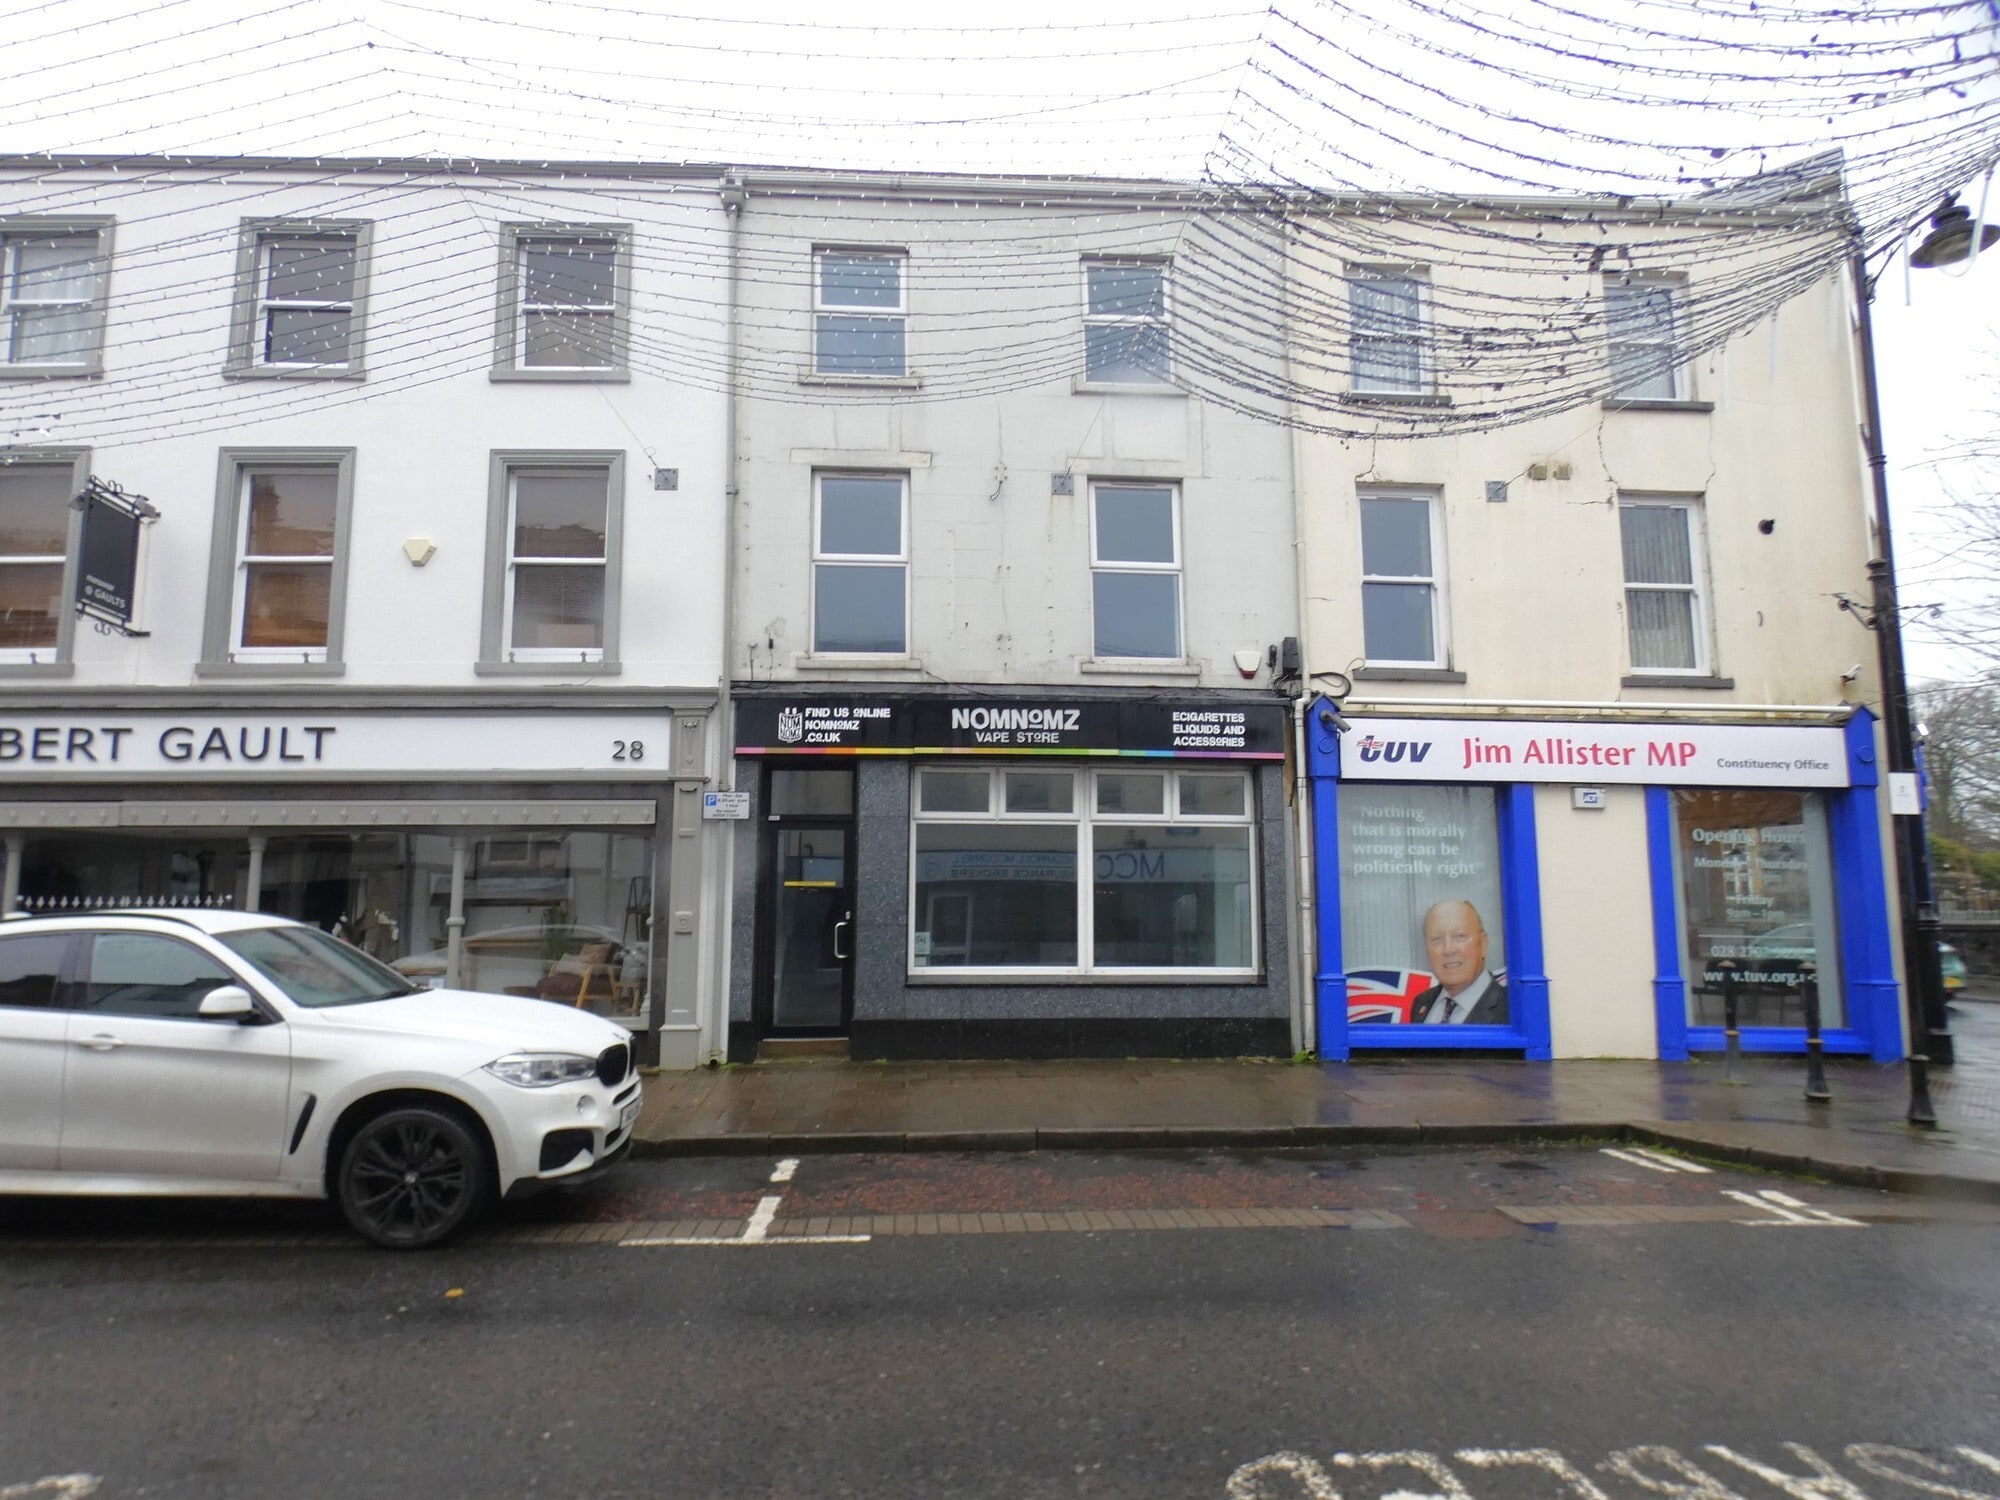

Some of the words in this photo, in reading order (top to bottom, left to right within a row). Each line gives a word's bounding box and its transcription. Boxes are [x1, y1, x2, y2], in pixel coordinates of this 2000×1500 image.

[94, 588, 126, 609] GAULTS
[805, 707, 831, 718] FIND
[833, 707, 850, 718] US
[853, 707, 891, 719] ONLINE
[951, 707, 1080, 730] NOMNOMZ
[1172, 711, 1246, 723] ECIGARETTES
[804, 719, 860, 731] NOMNOMZ
[1172, 723, 1221, 735] ELIQUIDS
[1223, 725, 1246, 735] AND
[0, 727, 133, 762] BERT
[158, 726, 337, 761] GAULT
[804, 732, 841, 743] .CO.UK
[975, 731, 1010, 743] VAPE
[1016, 732, 1060, 743] STORE
[1173, 736, 1246, 747] ACCESSORIES
[612, 740, 644, 760] 28
[1463, 737, 1512, 769] Jim
[1523, 738, 1637, 766] Allister
[1647, 742, 1697, 767] MP
[1717, 758, 1791, 771] Constituency
[1794, 759, 1830, 770] Office
[1353, 824, 1385, 837] that
[1390, 824, 1401, 837] is
[1406, 824, 1466, 840] morally
[1353, 844, 1403, 858] wrong
[1408, 845, 1436, 856] can
[1441, 842, 1460, 856] be
[1354, 860, 1433, 877] politically
